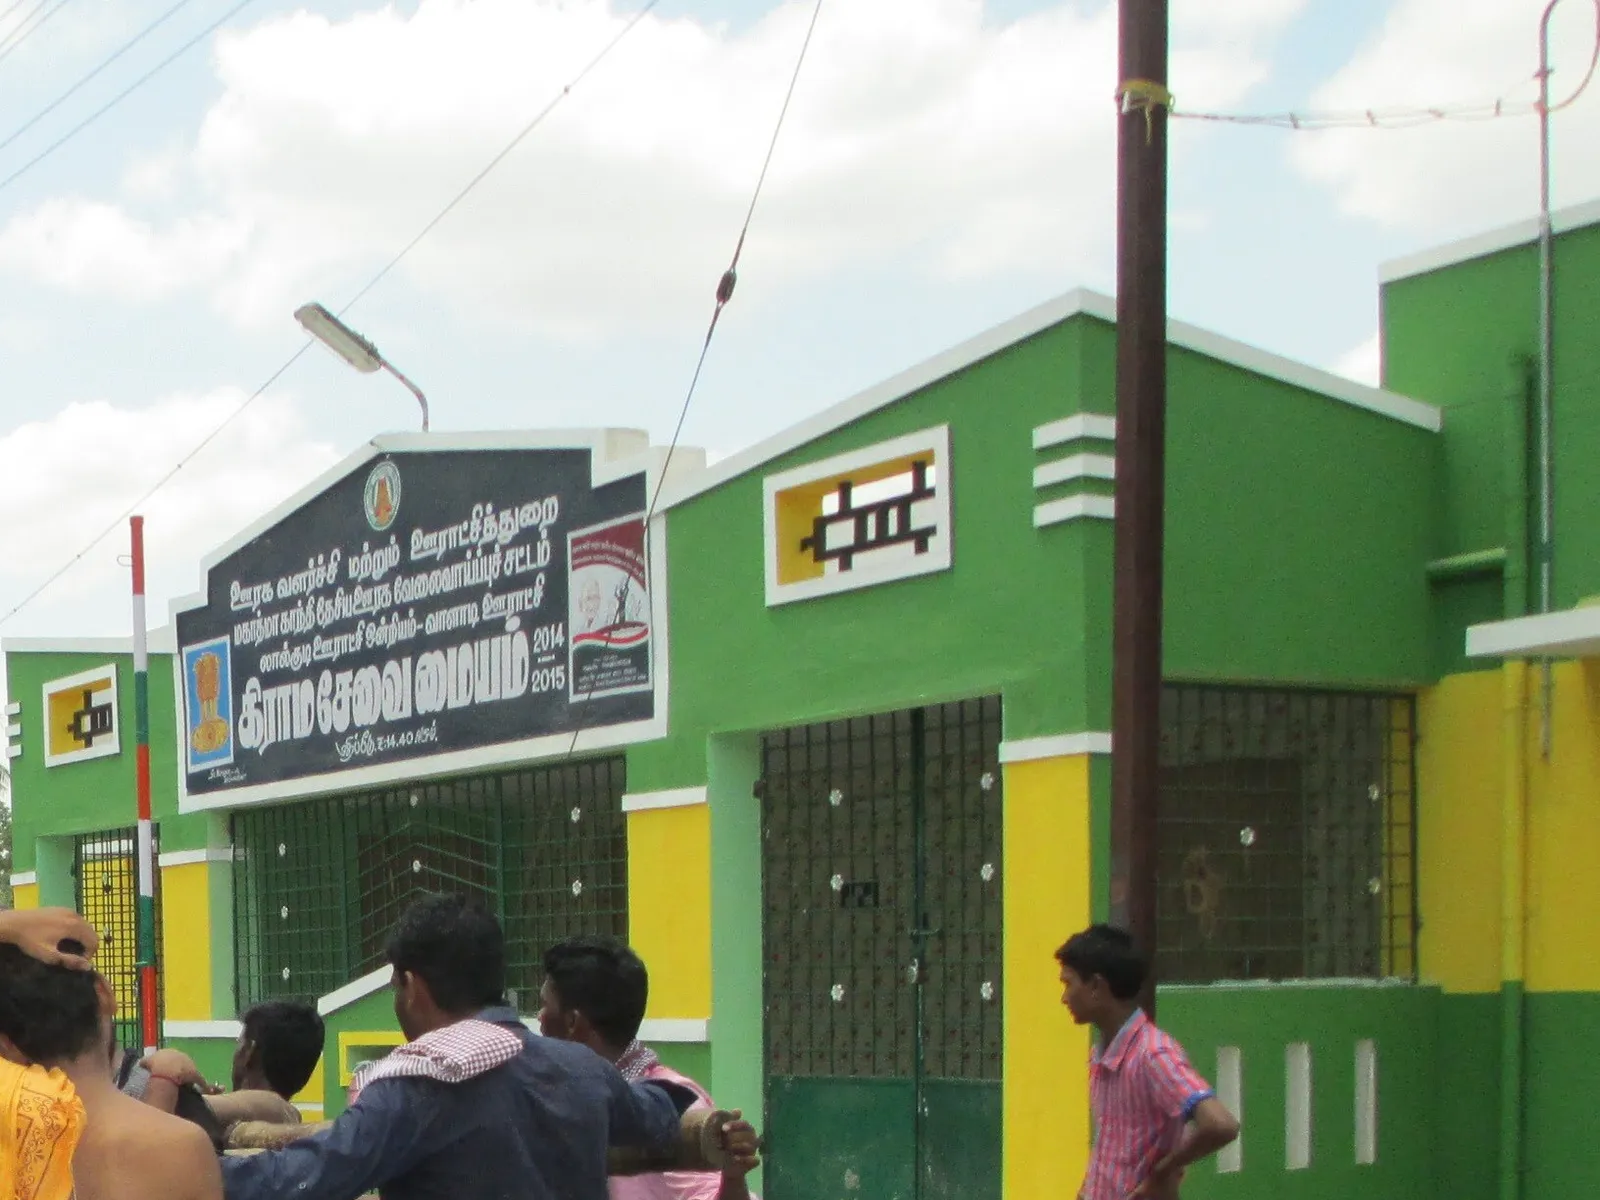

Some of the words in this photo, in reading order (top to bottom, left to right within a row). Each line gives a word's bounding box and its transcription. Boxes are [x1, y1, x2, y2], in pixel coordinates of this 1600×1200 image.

[230, 580, 274, 612] ஊரக
[277, 548, 341, 596] வளர்ச்சி
[348, 534, 400, 582] மற்றும்
[411, 495, 559, 561] ஊராட்சித்துறை
[234, 610, 279, 647] மகாத்மா
[280, 596, 316, 635] காந்தி
[316, 587, 352, 629] தேசிய
[353, 584, 392, 616] ஊரக
[260, 641, 312, 673] லால்குடி
[313, 619, 366, 661] ஊராட்சி
[425, 602, 479, 635] வாளாடி
[482, 572, 546, 621] ஊராட்சி
[533, 622, 566, 654] 2014
[414, 615, 530, 716] மையம்
[531, 664, 566, 693] 2015
